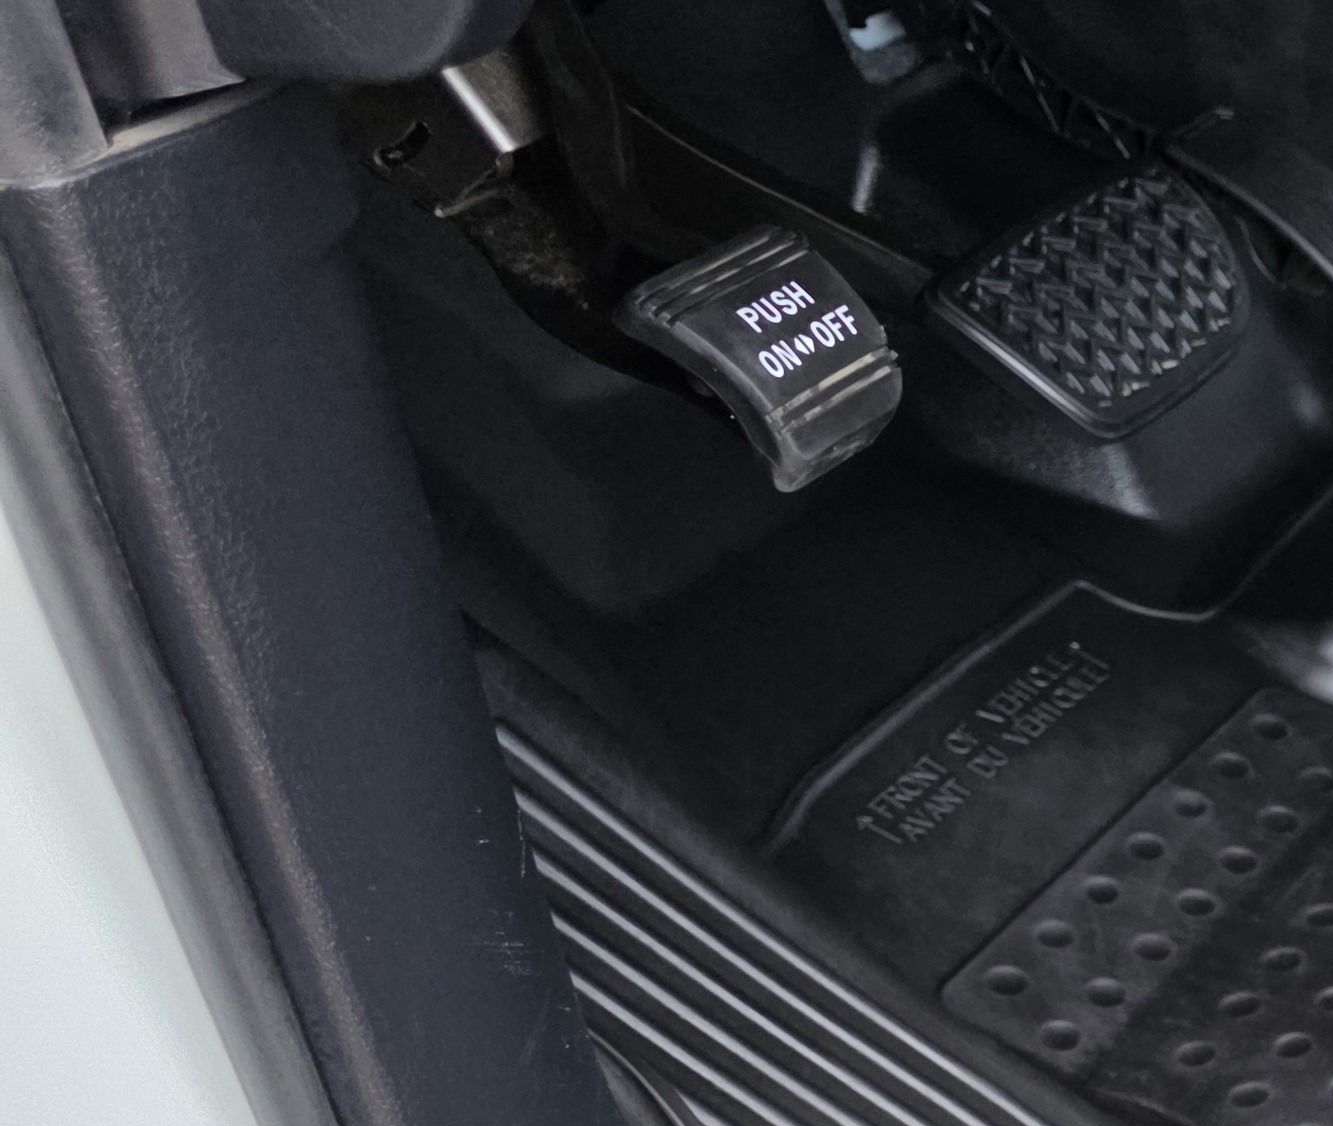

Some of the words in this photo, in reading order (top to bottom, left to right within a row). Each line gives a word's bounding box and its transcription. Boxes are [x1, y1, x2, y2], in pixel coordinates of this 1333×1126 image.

[736, 280, 816, 334] PUSH
[866, 752, 949, 820] FRONT
[943, 721, 980, 756] OF
[975, 650, 1076, 724] VEHICLE
[899, 776, 973, 843] AVANT
[966, 744, 1010, 780] DU
